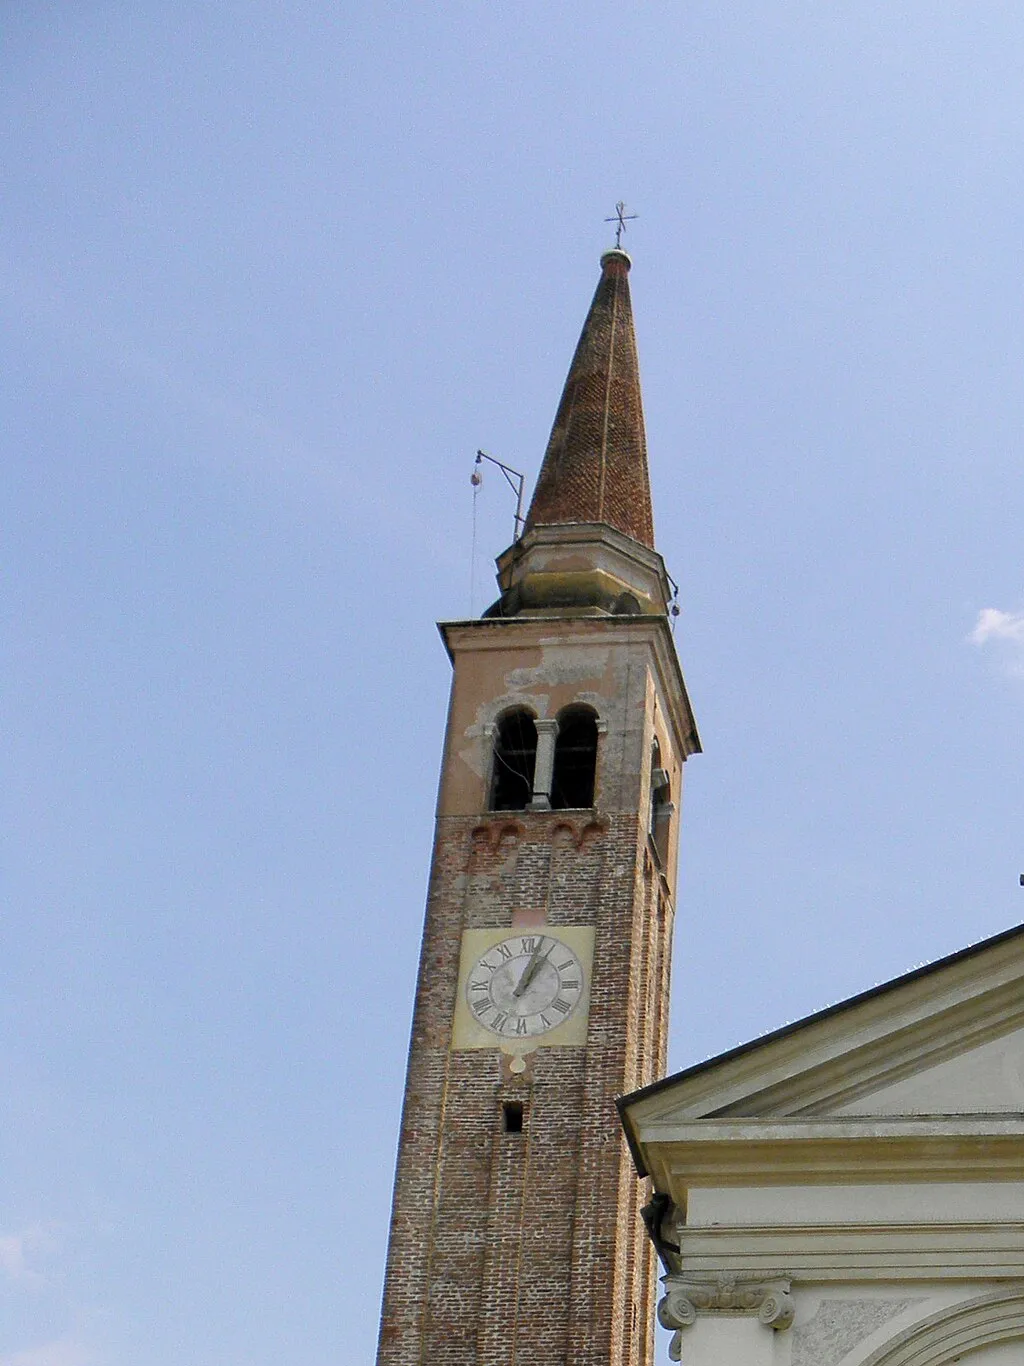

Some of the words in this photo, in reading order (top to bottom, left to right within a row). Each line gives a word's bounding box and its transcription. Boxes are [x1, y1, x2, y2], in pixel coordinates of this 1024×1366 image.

[496, 944, 513, 961] XI
[521, 938, 536, 954] XII
[480, 960, 497, 973] X
[557, 959, 574, 972] II
[471, 980, 489, 991] IX
[561, 980, 579, 990] III
[515, 1018, 527, 1034] VI
[540, 1013, 551, 1029] V
